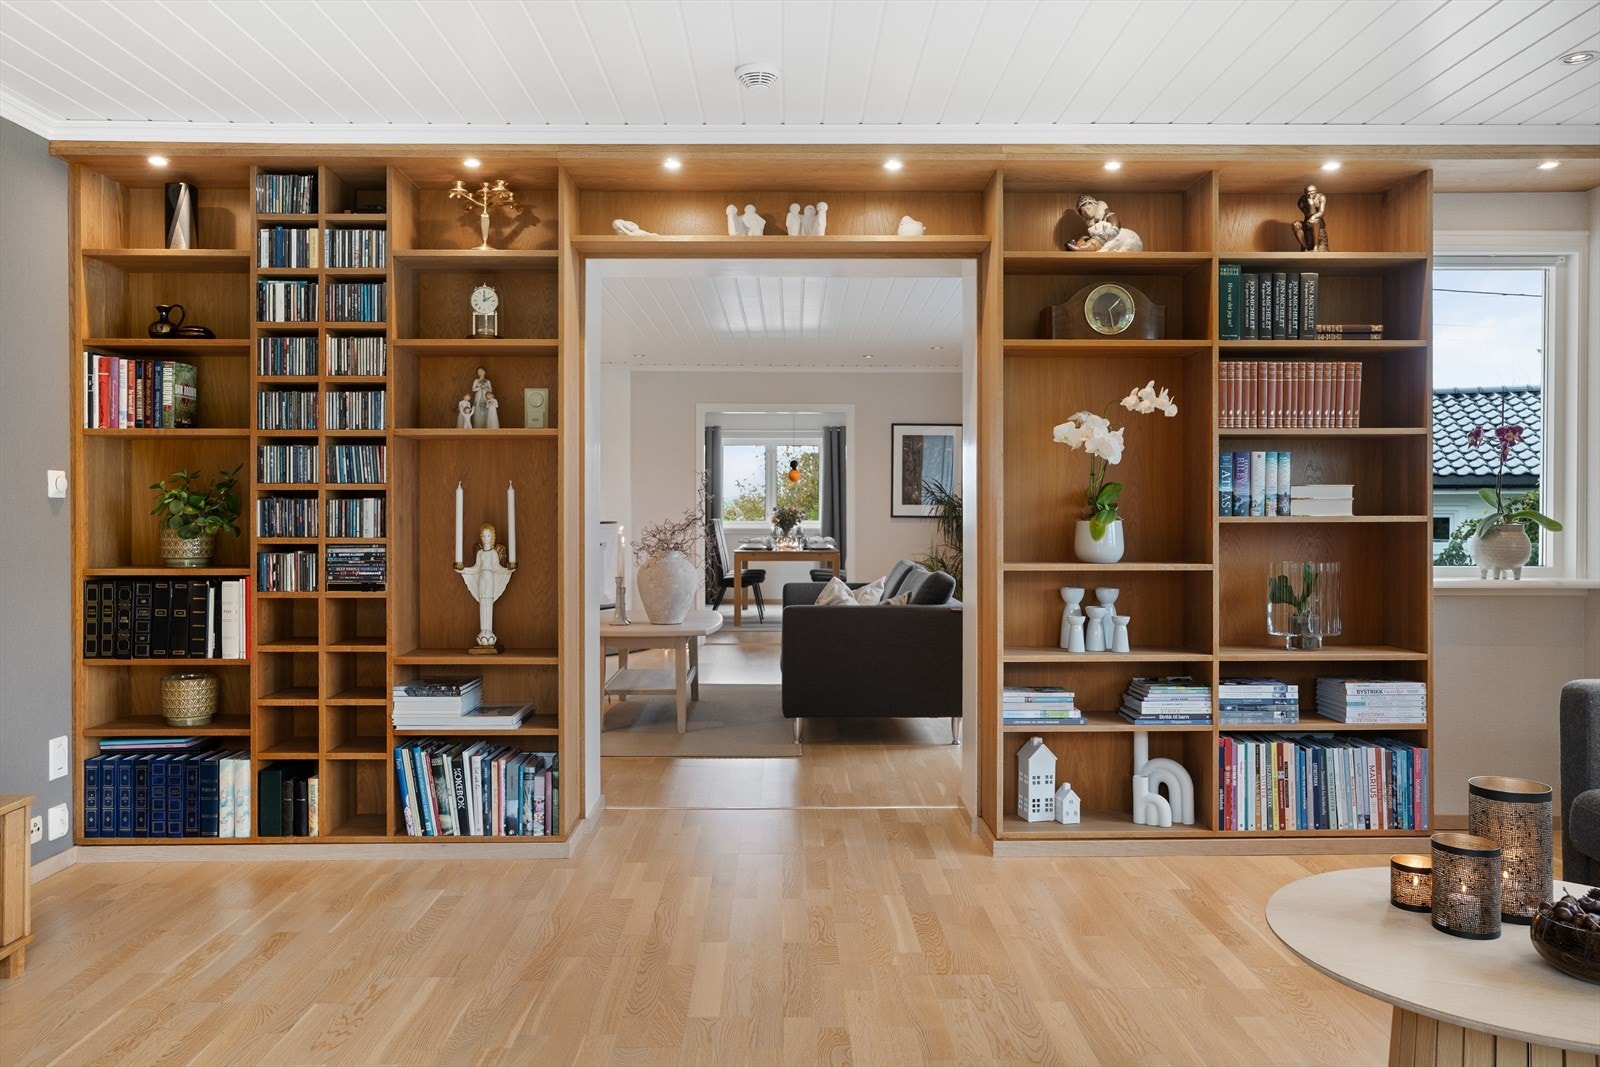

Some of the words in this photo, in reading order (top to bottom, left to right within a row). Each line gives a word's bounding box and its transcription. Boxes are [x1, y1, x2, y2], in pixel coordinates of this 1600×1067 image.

[163, 368, 172, 380] DAN
[163, 383, 173, 405] BROWN
[1222, 470, 1231, 508] ATLAS
[453, 768, 465, 809] KOKEBOK
